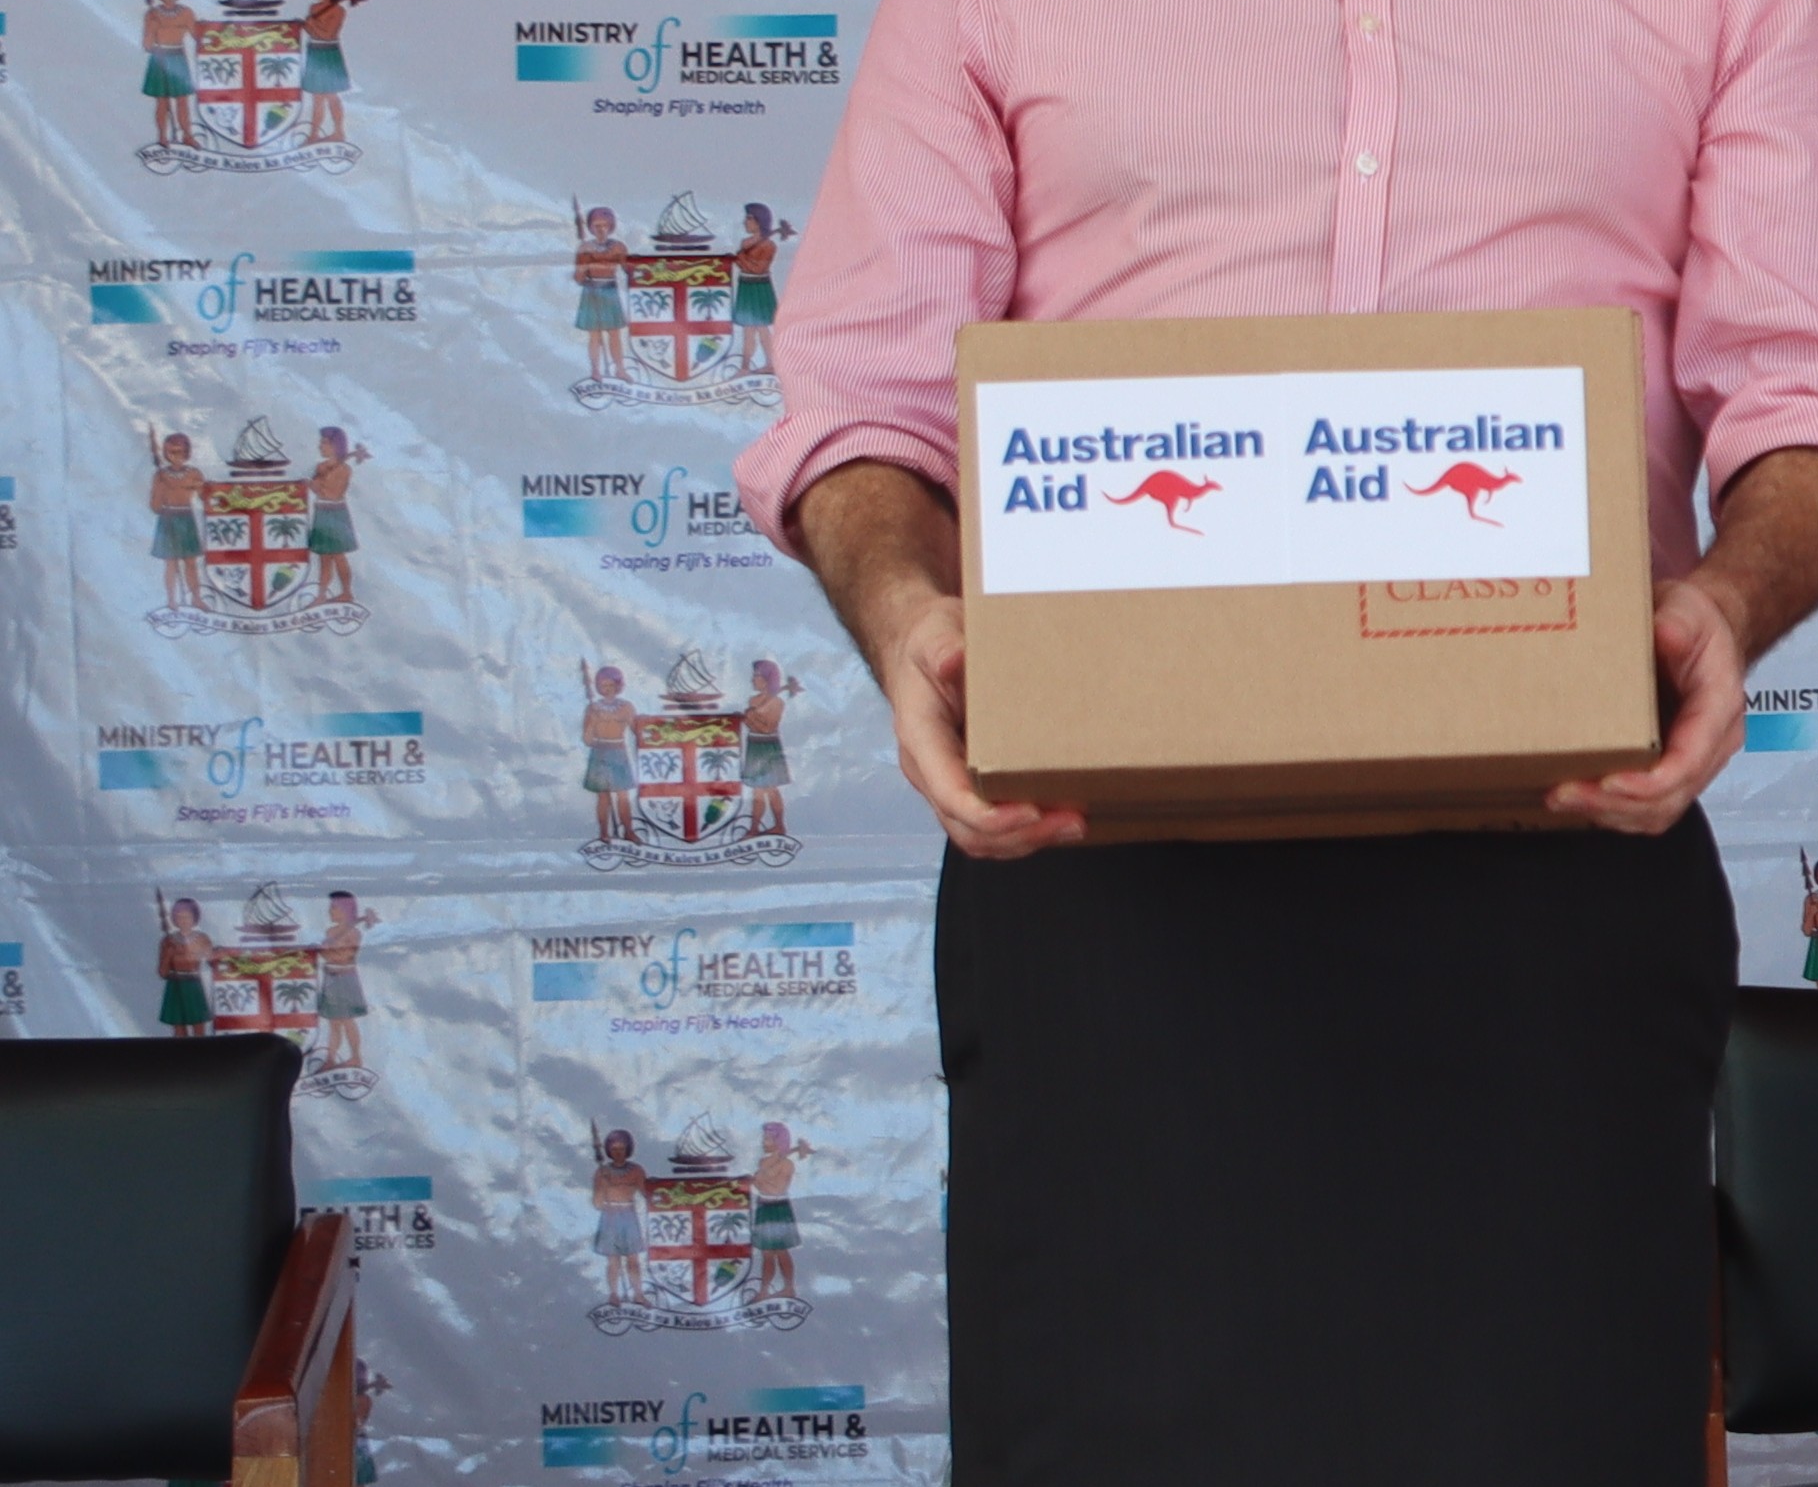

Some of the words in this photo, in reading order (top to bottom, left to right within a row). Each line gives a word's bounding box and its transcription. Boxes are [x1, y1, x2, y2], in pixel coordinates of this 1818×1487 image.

[517, 21, 638, 44] MINISTRY
[625, 16, 680, 94] of
[681, 42, 806, 68] HEALTH
[817, 42, 838, 68] &
[681, 70, 756, 84] MEDICAL
[761, 69, 840, 84] SERVICES
[593, 100, 662, 117] Shaping
[668, 100, 704, 115] Fiji's
[709, 99, 765, 115] Health
[89, 259, 212, 282] MINISTRY
[199, 253, 255, 333] of
[256, 278, 382, 305] HEALTH
[393, 278, 414, 304] &
[255, 308, 331, 322] MEDICAL
[336, 306, 416, 321] SERVICES
[166, 340, 237, 357] Shaping
[243, 340, 279, 355] Fiji's
[284, 338, 341, 354] Health
[1002, 423, 1265, 466] Australian
[1304, 416, 1565, 457] Australian
[1003, 474, 1087, 513] Aid
[1305, 465, 1389, 503] Aid
[523, 474, 645, 497] MINISTRY
[632, 468, 687, 548] of
[600, 555, 670, 571] Shaping
[675, 554, 712, 569] Fiji's
[717, 552, 773, 568] Health
[98, 724, 221, 749] MINISTRY
[208, 717, 264, 799] of
[265, 741, 392, 769] HEALTH
[403, 739, 424, 767] &
[265, 771, 340, 787] MEDICAL
[346, 768, 425, 785] SERVICES
[176, 806, 246, 824] Shaping
[252, 805, 288, 821] Fiji's
[294, 802, 350, 819] Health
[532, 934, 654, 960] MINISTRY
[641, 927, 696, 1011] of
[698, 951, 823, 981] HEALTH
[834, 950, 855, 977] &
[697, 982, 772, 998] MEDICAL
[778, 979, 857, 996] SERVICES
[610, 1017, 679, 1036] Shaping
[685, 1016, 721, 1033] Fiji's
[726, 1013, 782, 1031] Health
[542, 1400, 664, 1426] MINISTRY
[651, 1392, 707, 1476] of
[708, 1415, 834, 1445] HEALTH
[844, 1413, 866, 1441] &
[708, 1446, 783, 1462] MEDICAL
[788, 1442, 867, 1460] SERVICES
